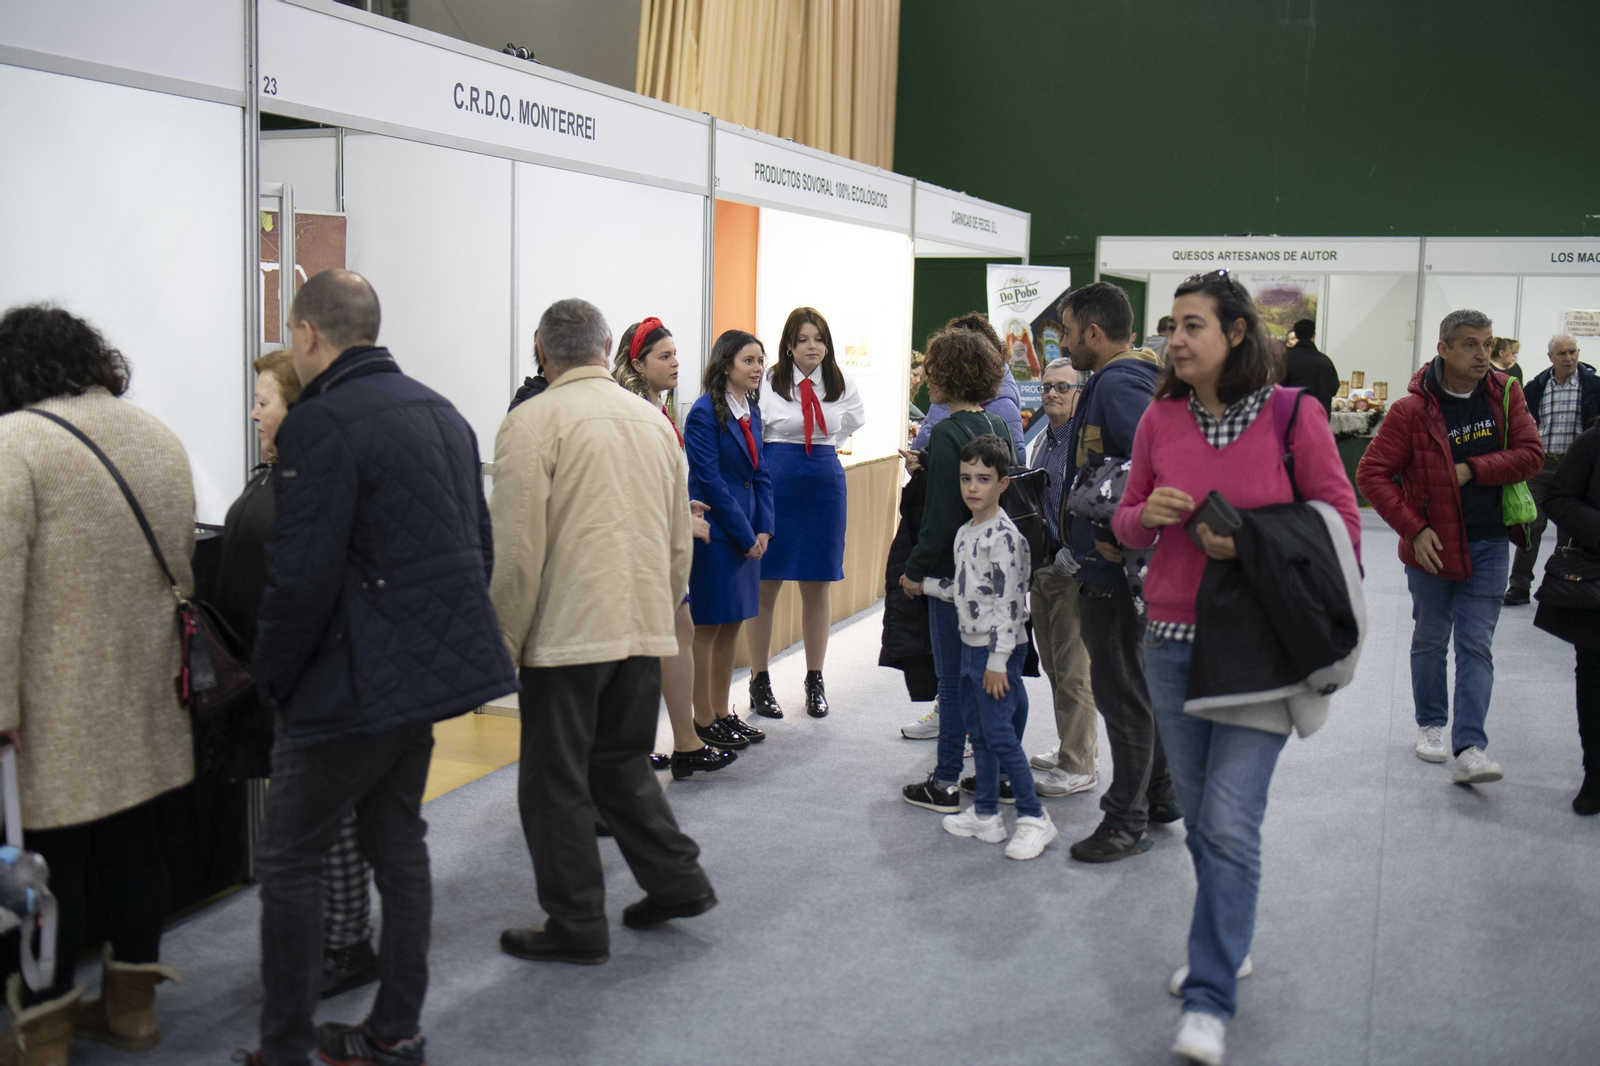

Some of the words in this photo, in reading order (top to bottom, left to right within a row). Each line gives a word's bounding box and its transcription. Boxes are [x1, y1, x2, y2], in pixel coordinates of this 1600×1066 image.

[263, 75, 278, 96] 23
[453, 82, 514, 122] C.R.D.O.
[519, 99, 596, 141] MONTERREI
[754, 162, 801, 189] PRODUCTOS
[802, 173, 834, 197] SOVORAL
[835, 181, 850, 201] 100%
[851, 184, 888, 209] ECOLÓGICOS
[1172, 250, 1215, 261] QUESOS
[1217, 250, 1280, 261] ARTESANOS
[1283, 250, 1298, 261] DE
[1300, 250, 1337, 261] AUTOR
[1551, 252, 1574, 263] LOS
[999, 292, 1014, 303] Do
[1014, 285, 1038, 303] Pobo
